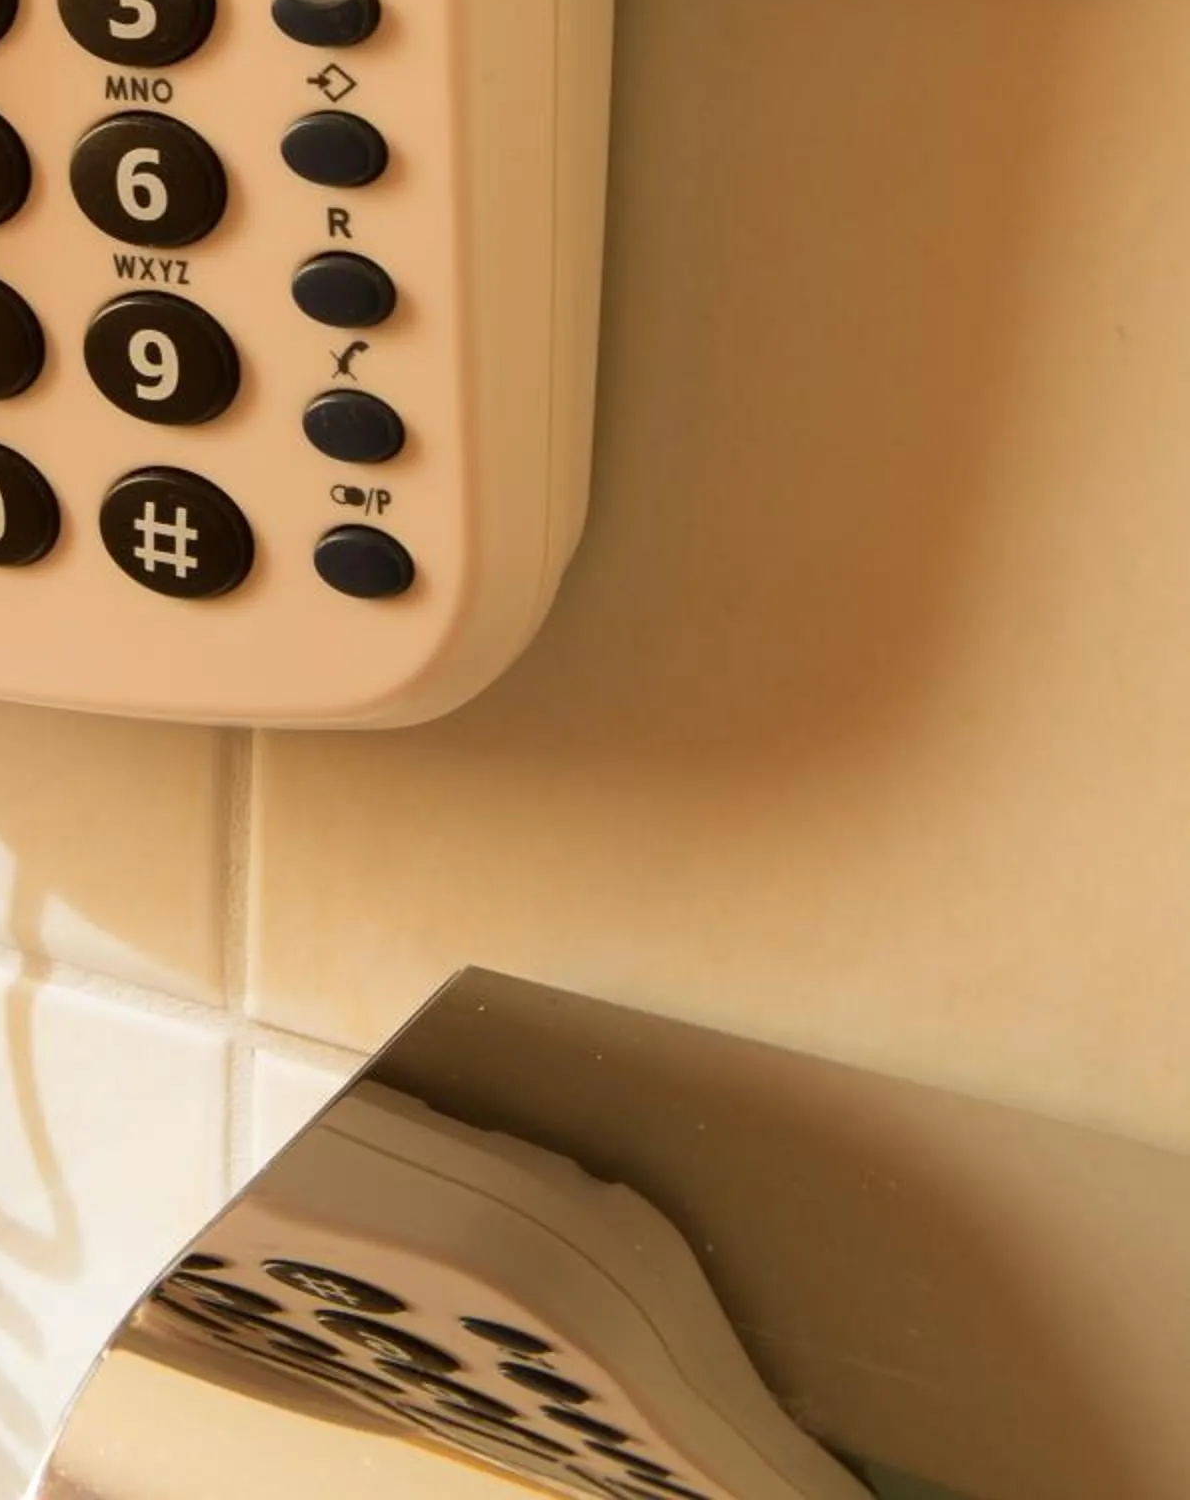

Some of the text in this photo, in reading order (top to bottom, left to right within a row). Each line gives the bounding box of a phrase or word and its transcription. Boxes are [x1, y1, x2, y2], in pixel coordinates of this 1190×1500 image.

[105, 75, 173, 105] MNO
[116, 147, 168, 221] 6
[327, 207, 353, 239] R
[112, 254, 190, 285] WXYZ
[128, 329, 179, 401] 9
[133, 501, 198, 578] #
